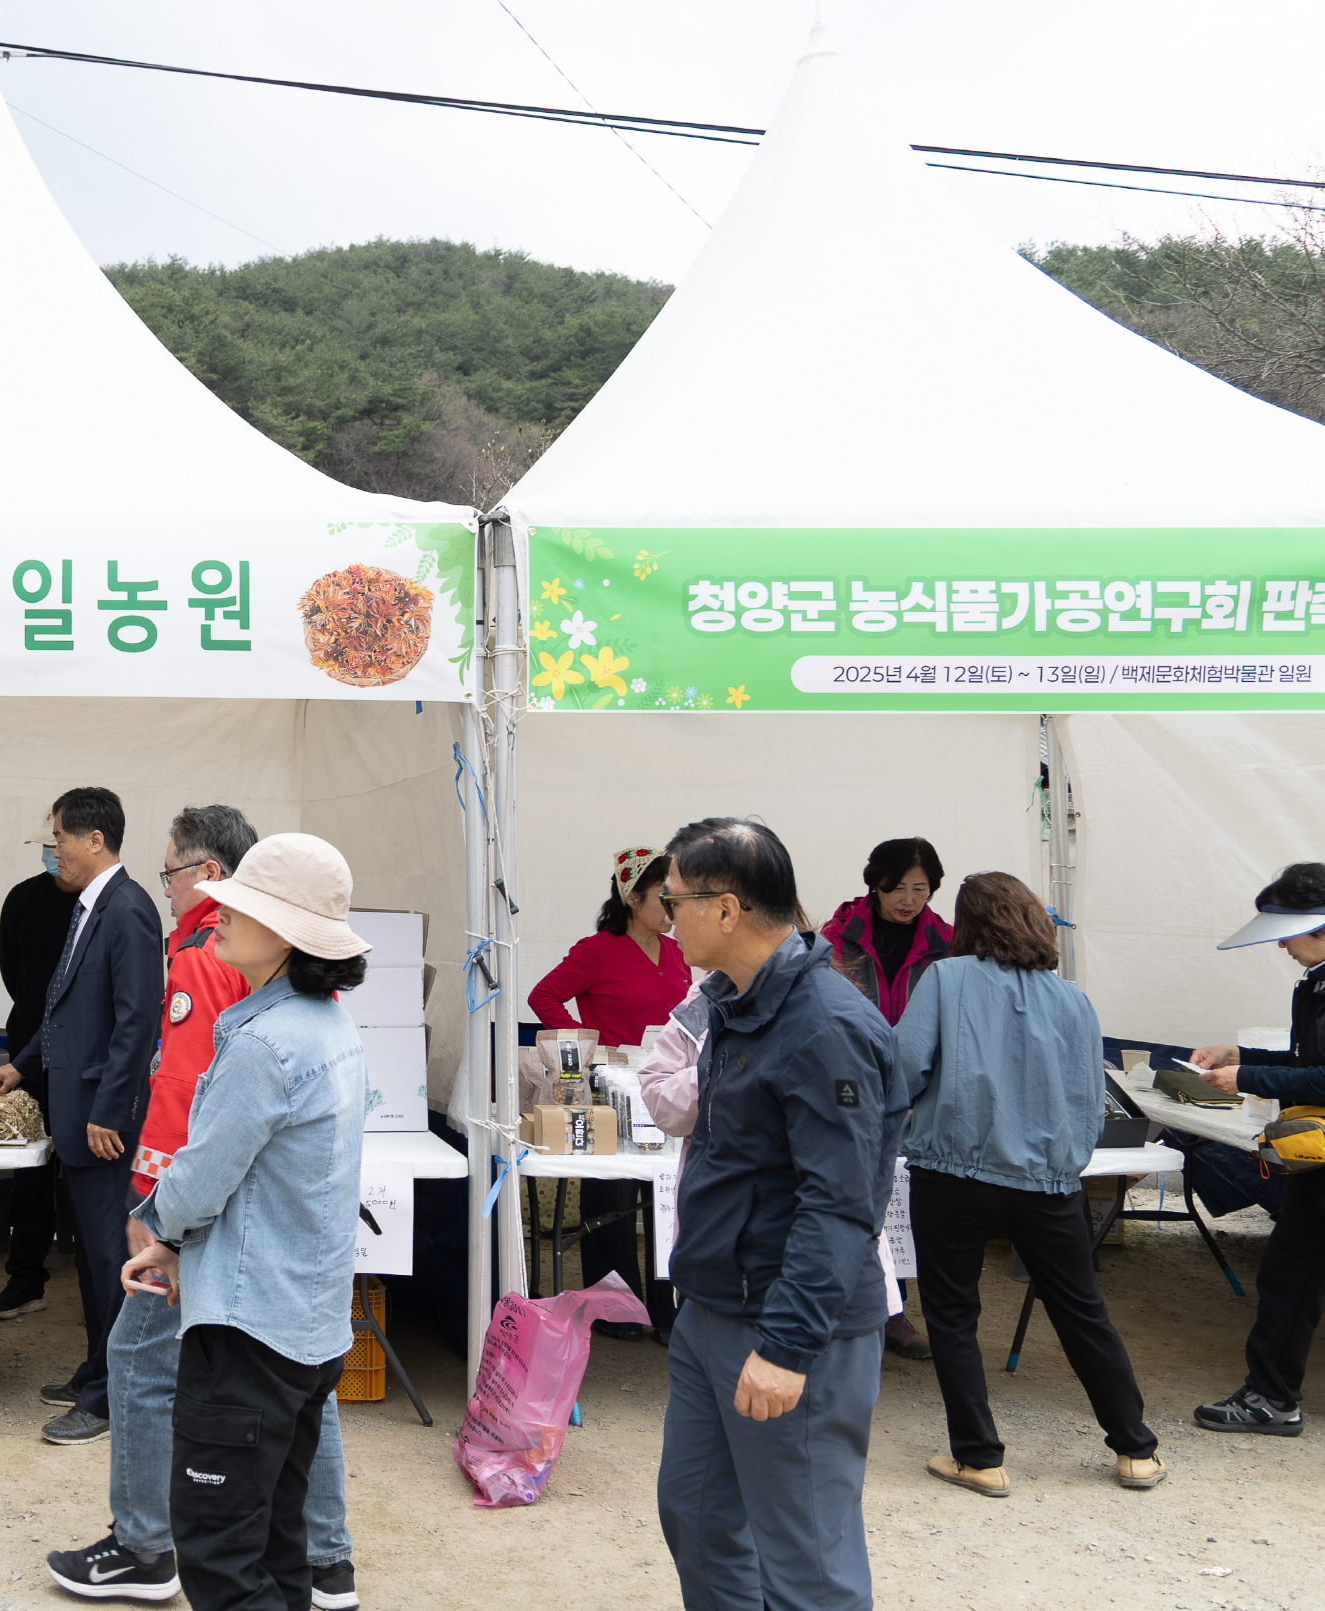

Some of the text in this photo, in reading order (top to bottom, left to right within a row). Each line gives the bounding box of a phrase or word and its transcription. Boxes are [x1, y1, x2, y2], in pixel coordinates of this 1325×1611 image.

[687, 579, 837, 633] 청양군
[849, 579, 1252, 633] 농식품가공연구회
[833, 665, 902, 684] 2025년
[906, 665, 937, 684] 4월
[943, 664, 1013, 685] 12일(토)
[1036, 665, 1106, 685] 13일(일)
[1121, 665, 1275, 685] 백제문화체험박물관
[1279, 665, 1312, 684] 일원
[186, 1467, 227, 1485] Discovery
